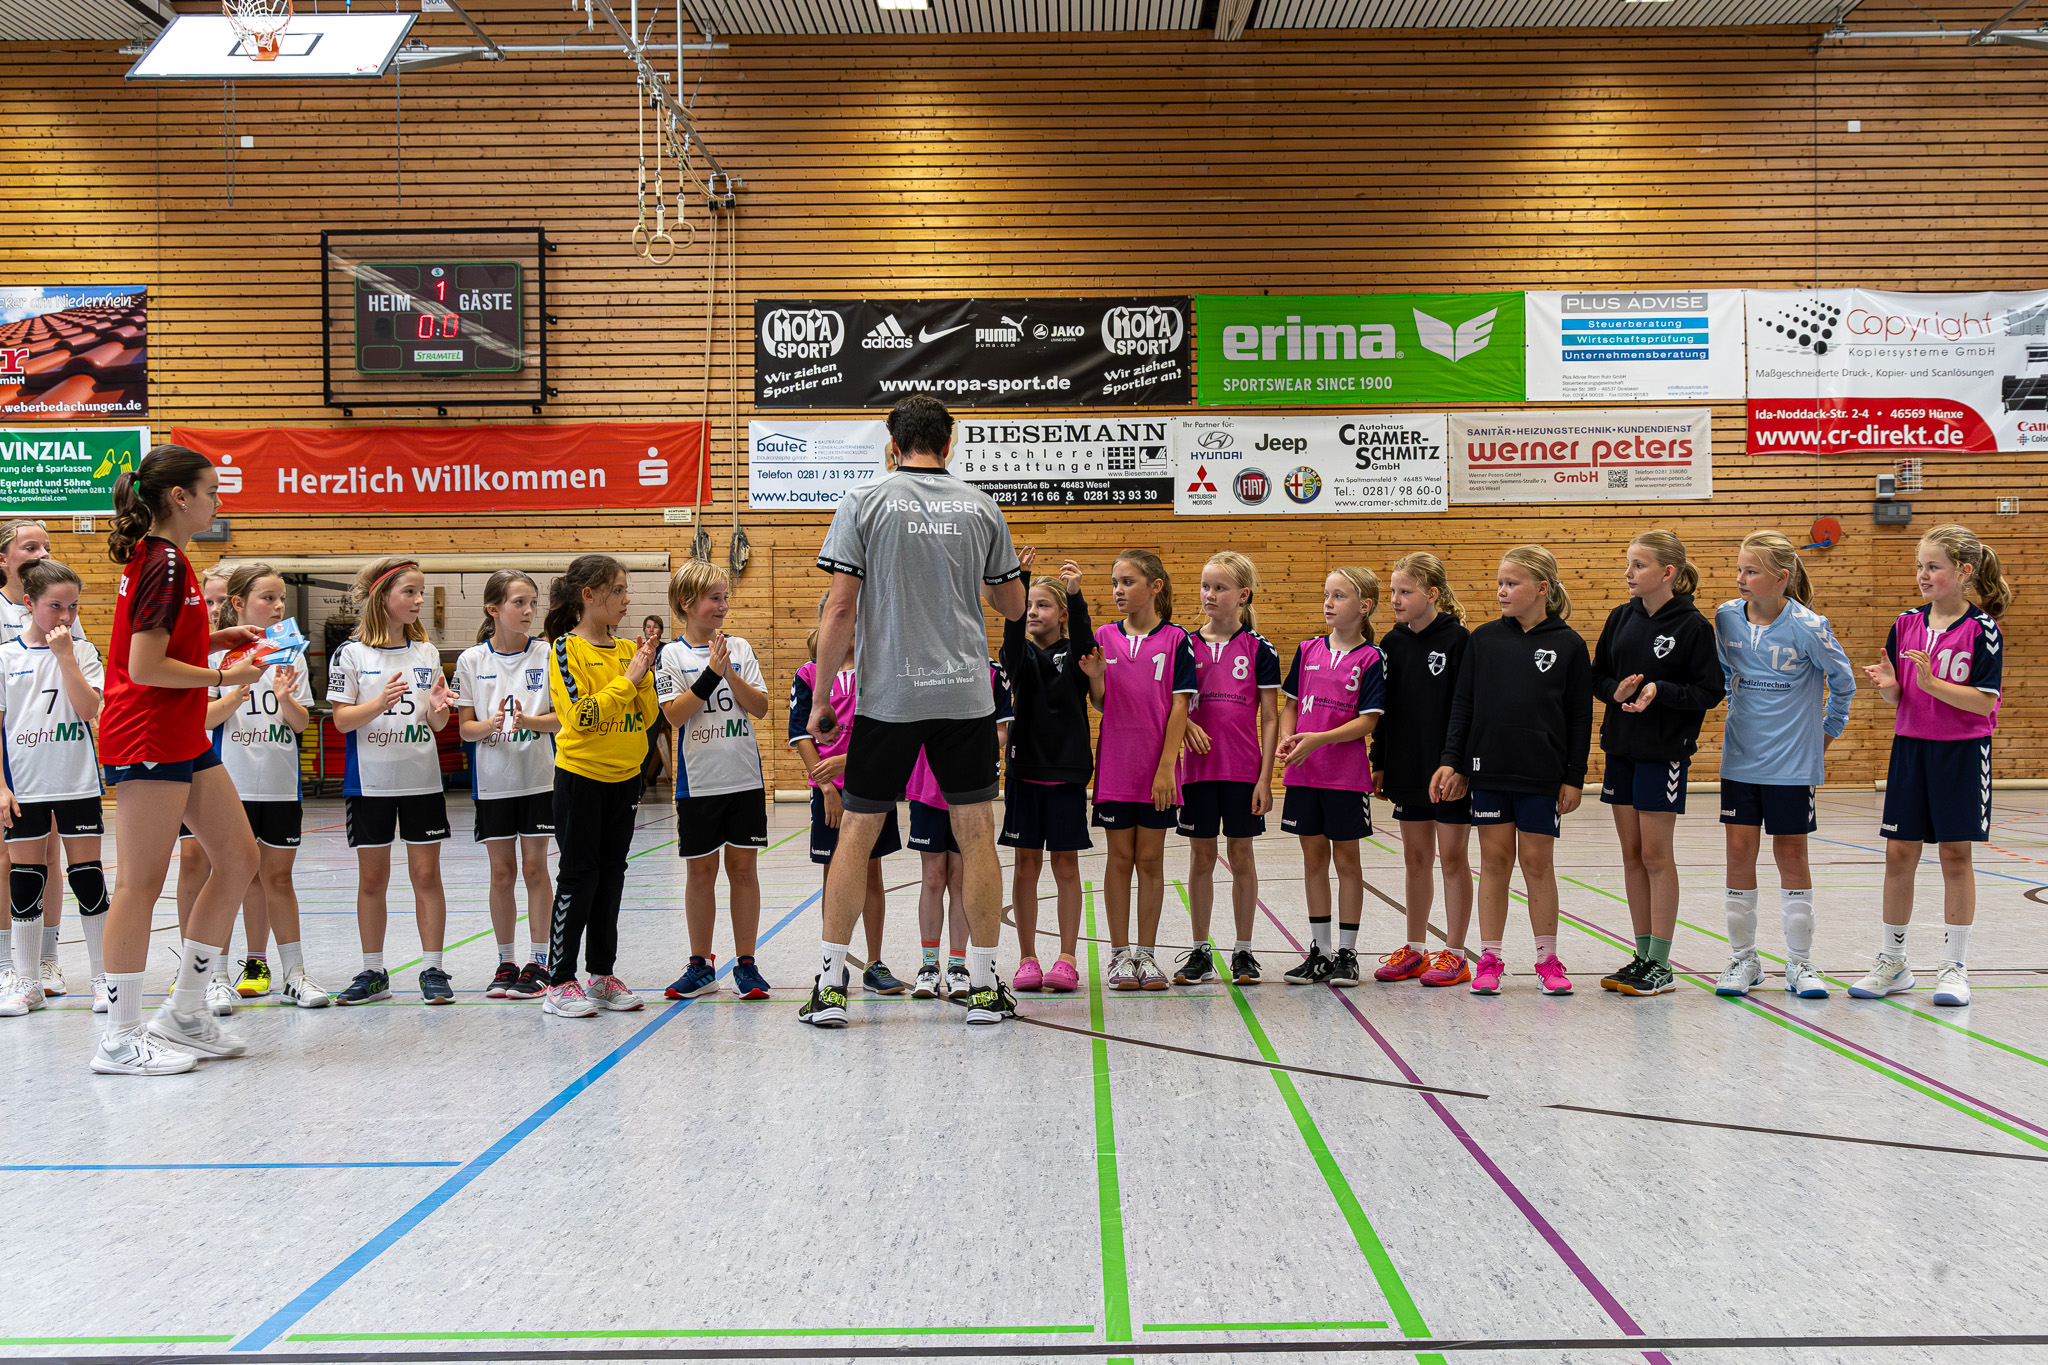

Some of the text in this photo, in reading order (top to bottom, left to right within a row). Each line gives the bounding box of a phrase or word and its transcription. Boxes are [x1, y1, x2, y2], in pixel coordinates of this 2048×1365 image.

[436, 280, 446, 301] 1
[30, 292, 132, 309] am Niederrhein
[368, 289, 513, 312] HEIM GÄSTE
[1566, 296, 1704, 310] PLUS ADVISE
[774, 309, 833, 342] ROPA
[1113, 305, 1172, 339] ROPA
[1588, 320, 1682, 329] Steuerberatung
[1846, 309, 1993, 342] Copyright
[976, 328, 1017, 343] PUMA
[1051, 325, 1085, 337] JAKO
[1223, 315, 1396, 361] erima
[861, 336, 914, 349] adidas
[1116, 339, 1169, 356] SPORT
[1576, 335, 1694, 344] Wirtschaftsprüfung
[416, 351, 462, 360] STRAMATEL
[777, 343, 830, 359] SPORT
[1565, 350, 1706, 360] Unternehmensberatung
[1848, 346, 1996, 358] Kopiersysteme GmbH
[764, 363, 837, 384] Wir ziehen
[1103, 359, 1176, 381] Wir ziehen
[1755, 368, 1995, 379] Maßgeschneiderte Druck-, Kopier- und Scanlösungen
[763, 372, 843, 398] Sportler an!
[879, 377, 1071, 395] www.ropa-sport.de
[1102, 368, 1182, 396] Sportler an!
[1223, 376, 1393, 392] SPORTSWEAR SINCE 1900
[1755, 408, 1964, 421] Ida-Noddack-Str. 2-4 46569 Hünxe
[1183, 420, 1235, 429] Ihr Partner für:
[965, 423, 1168, 444] BIESEMANN
[1339, 423, 1430, 446] CRAMER-
[1755, 425, 1964, 446] www.cr-direkt.de
[757, 440, 807, 453] bautec
[1255, 433, 1308, 454] Jeep
[1468, 435, 1693, 468] werner peters
[965, 447, 1106, 460] Tischlerei
[1191, 451, 1243, 461] HYUNDAI
[1355, 445, 1441, 471] SCHMITZ
[22, 464, 93, 475] der Sparkassen
[966, 460, 1104, 473] Bestattungen
[1107, 469, 1168, 477] www.Biesemann.de
[1371, 462, 1401, 471] GmbH
[1, 478, 92, 488] Egerlandt und Söhne
[277, 464, 606, 494] Herzlich Willkommen
[758, 470, 874, 480] Telefon 0281 / 31 93 777
[1345, 476, 1391, 484] Spaltmannsfeld
[1553, 471, 1599, 483] GmbH
[1040, 480, 1110, 489] 6b 46483 Wesel
[1243, 478, 1264, 496] FIAT
[1334, 485, 1442, 498] Tel.: 0281/ 98 60-0
[992, 490, 1158, 502] 0281 2 16 66 & 0281 33 93 30
[1334, 498, 1442, 508] www.cramer-schmitz.de
[886, 499, 982, 516] HSG WESEL
[908, 521, 962, 535] DANIEL
[834, 562, 853, 573] Kempa
[1768, 645, 1798, 671] 12
[1936, 649, 1972, 683] 16
[1152, 652, 1166, 681] 1
[1232, 655, 1250, 680] 8
[914, 676, 975, 687] Handball in Wesel
[1345, 666, 1361, 692] 3
[41, 689, 59, 714] 7
[246, 690, 279, 715] 10
[383, 691, 416, 716] 15
[16, 721, 85, 748] eightMS
[231, 723, 293, 747] eightMS
[367, 724, 431, 747] eightMS
[691, 719, 750, 744] eightMS
[1011, 745, 1017, 759] 5
[1472, 757, 1481, 771] 13
[1474, 810, 1501, 818] hummel
[910, 836, 930, 845] hummel
